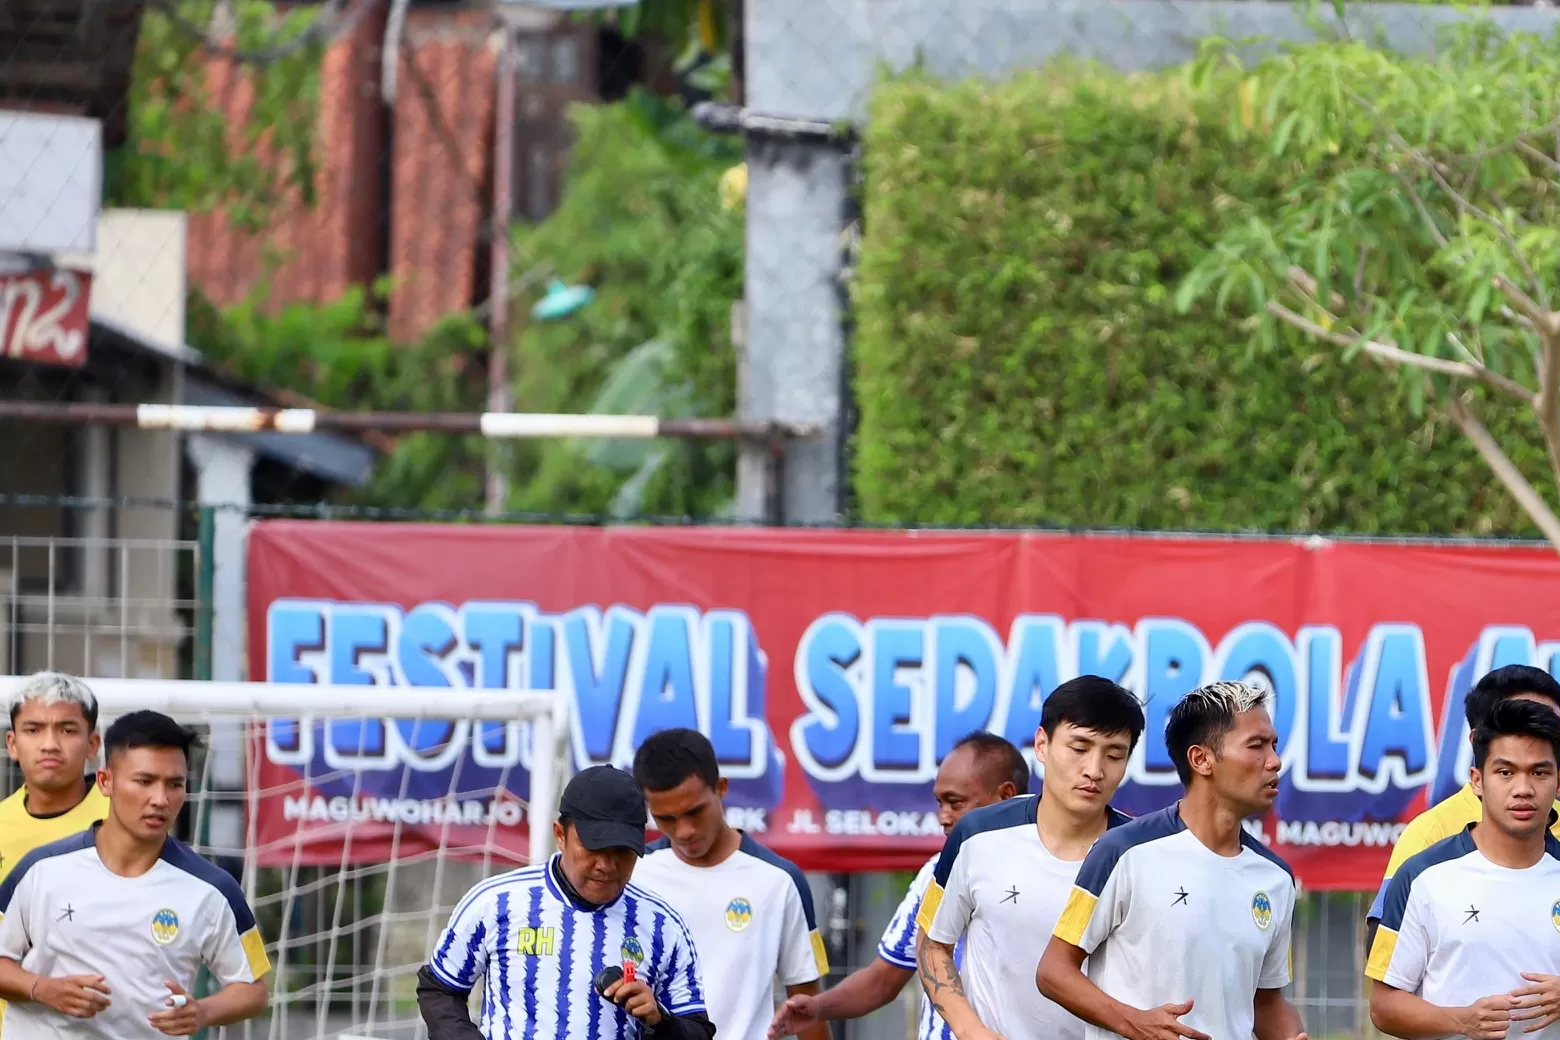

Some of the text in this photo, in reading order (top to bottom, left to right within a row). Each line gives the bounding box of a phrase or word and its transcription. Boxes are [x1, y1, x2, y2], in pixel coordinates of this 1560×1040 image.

[283, 794, 521, 826] MAGUWOHARJO
[826, 810, 945, 836] SELOKA
[517, 926, 555, 956] RH
